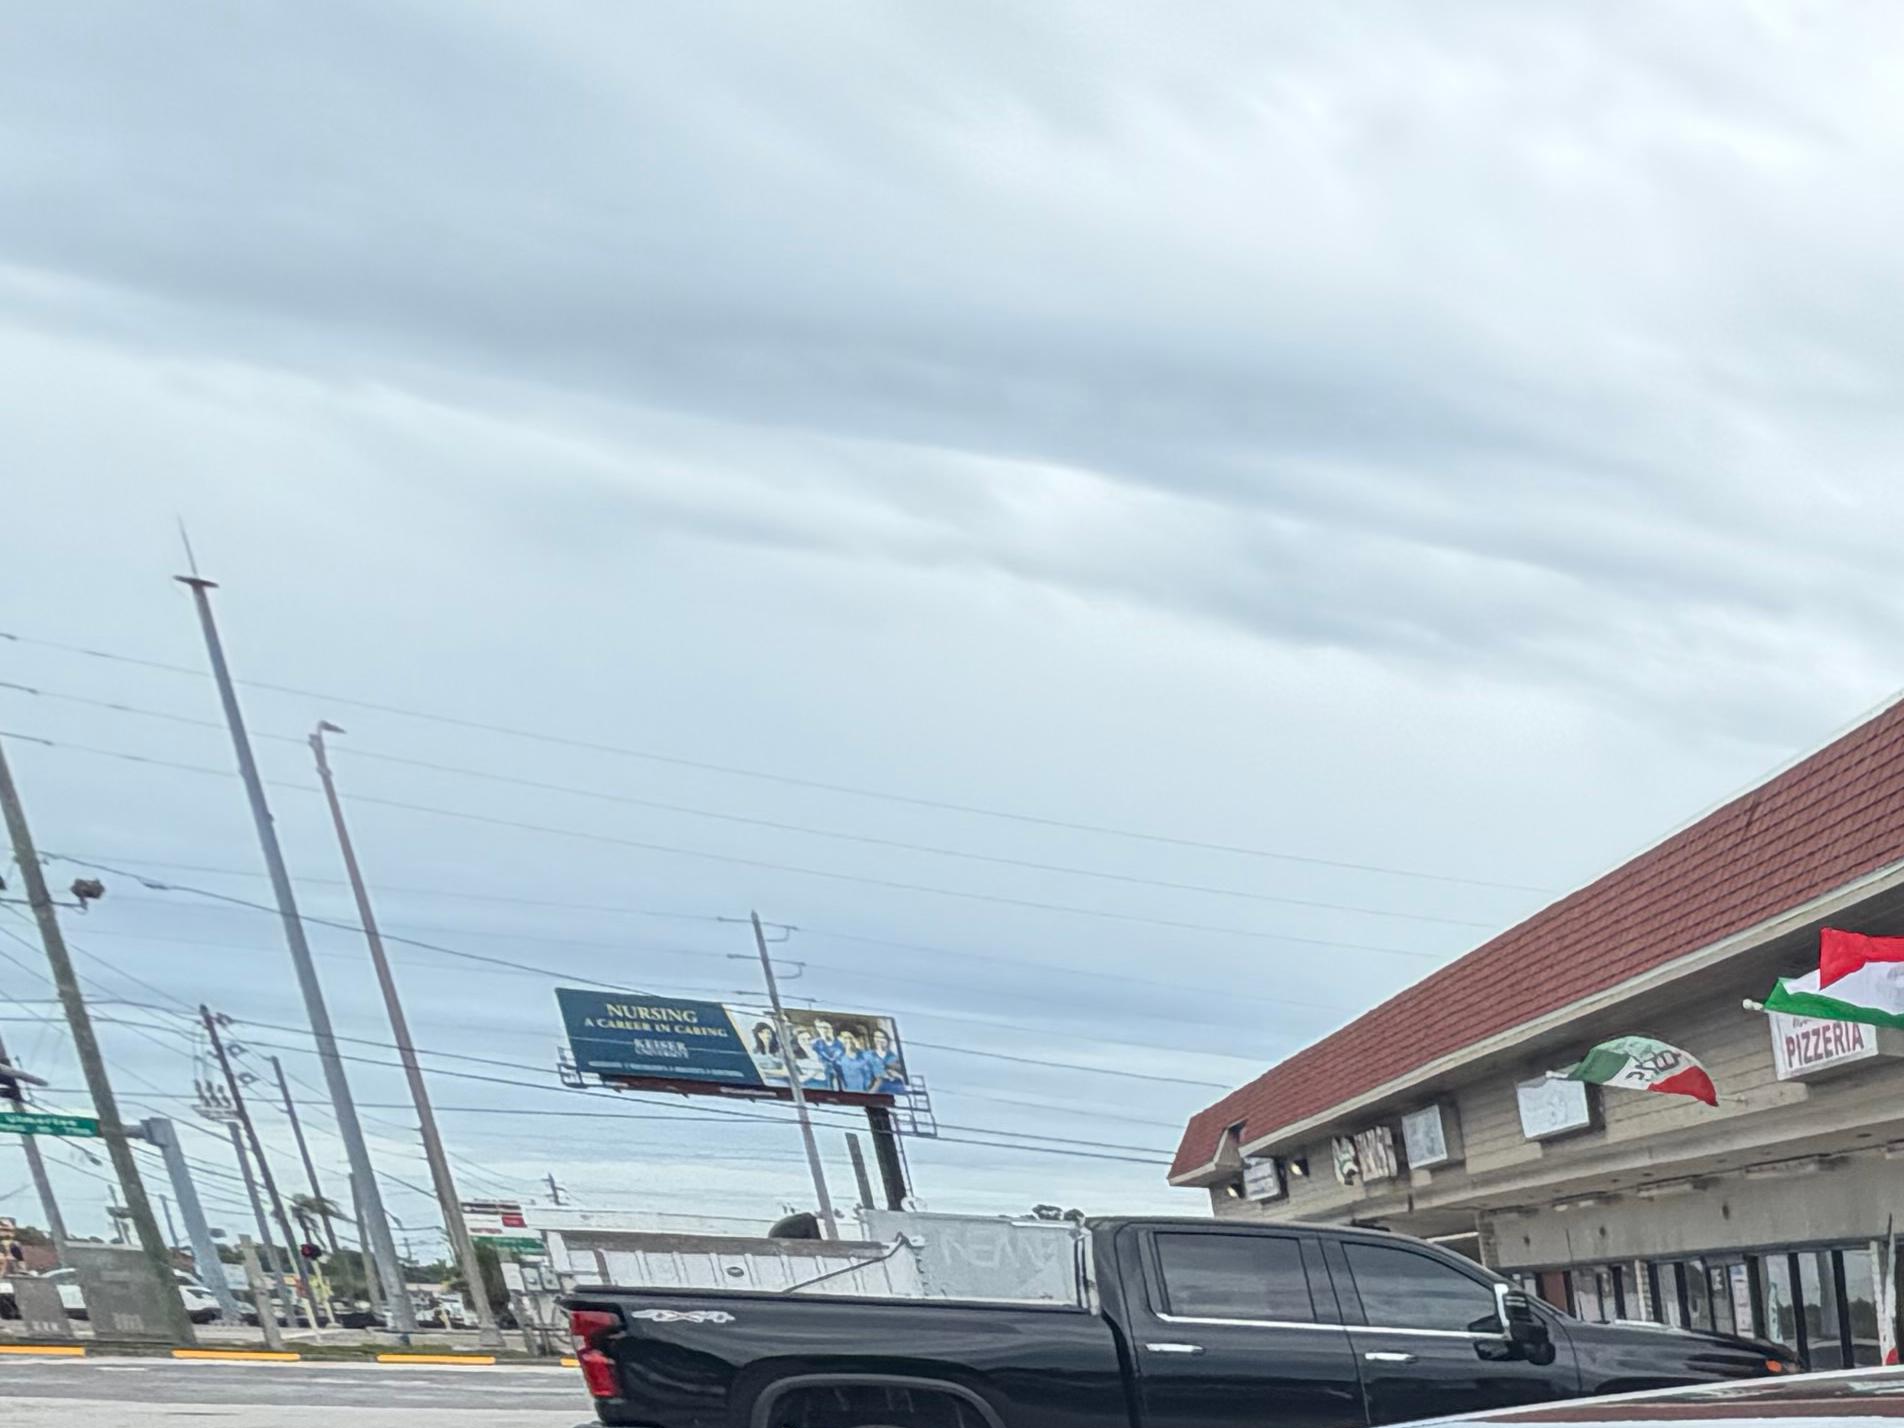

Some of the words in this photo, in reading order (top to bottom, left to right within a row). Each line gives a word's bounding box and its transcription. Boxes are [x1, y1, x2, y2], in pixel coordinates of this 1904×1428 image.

[606, 1003, 698, 1023] NURSING
[584, 1017, 594, 1027] A
[596, 1018, 652, 1032] CAREER
[655, 1023, 671, 1033] IN
[674, 1025, 728, 1037] CARING
[1785, 1022, 1864, 1068] PIZZERIA
